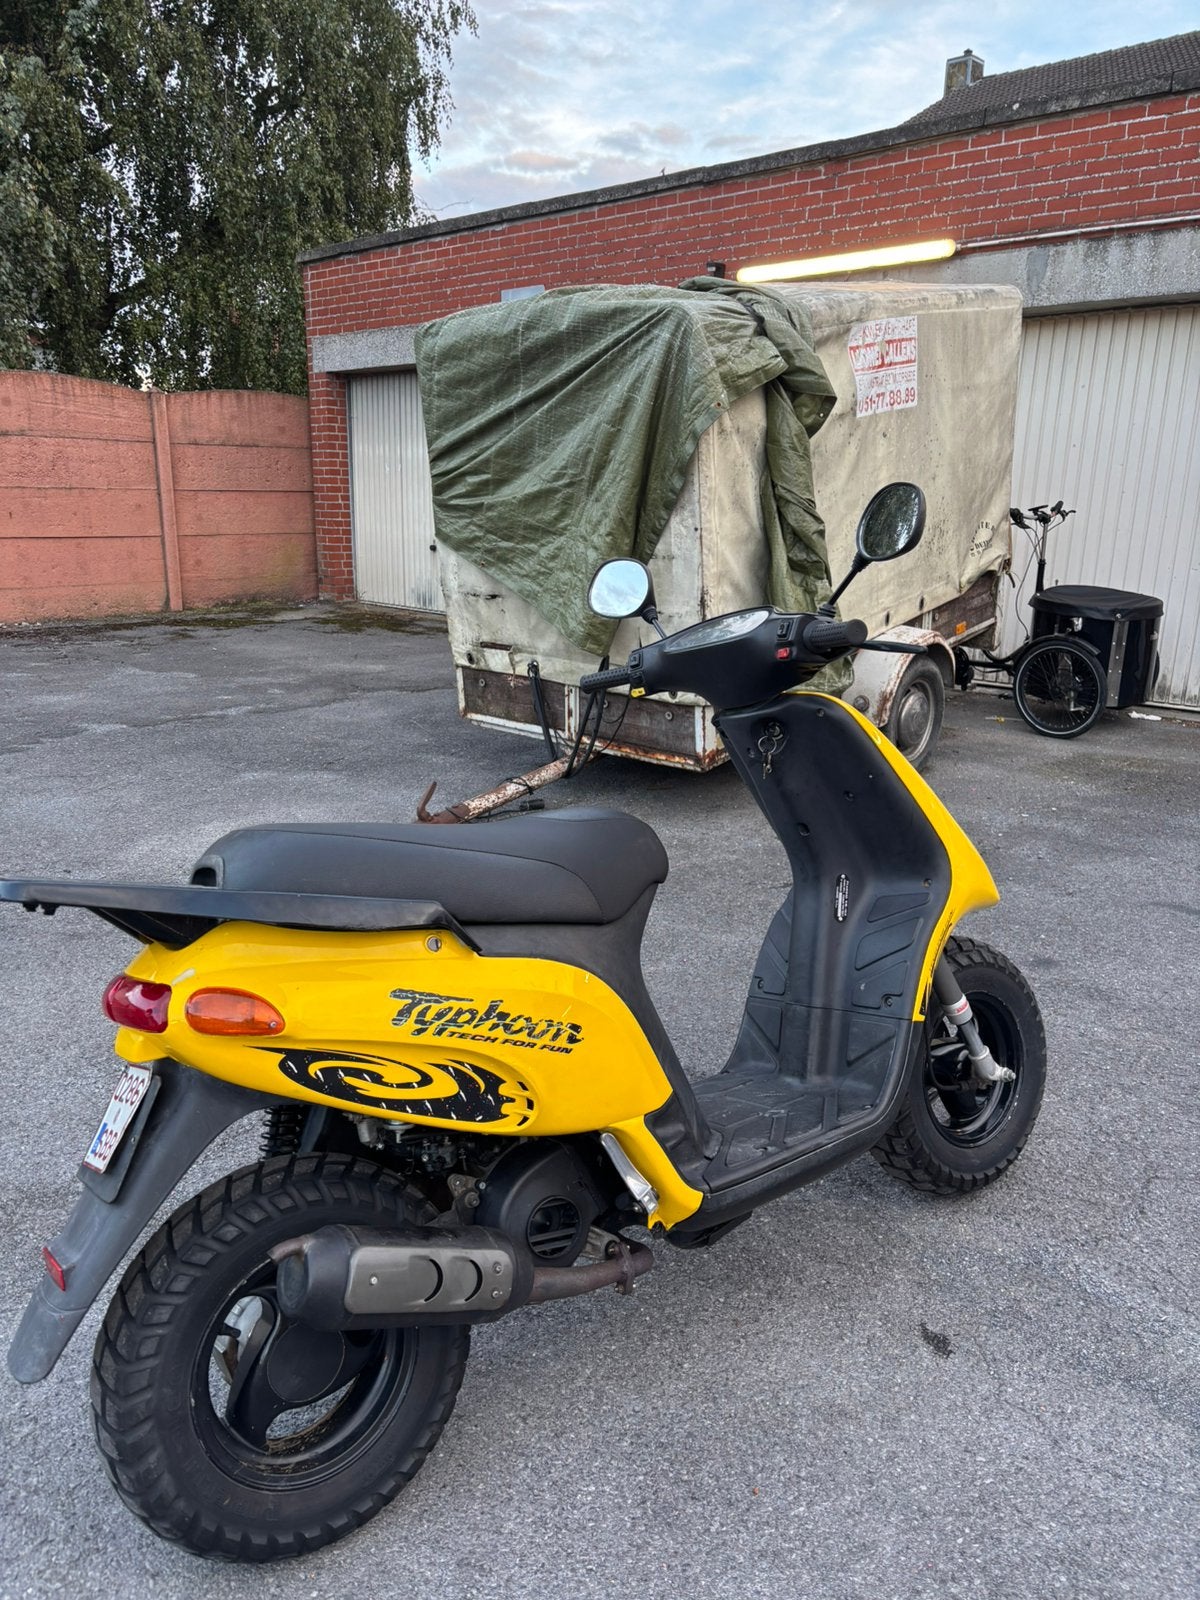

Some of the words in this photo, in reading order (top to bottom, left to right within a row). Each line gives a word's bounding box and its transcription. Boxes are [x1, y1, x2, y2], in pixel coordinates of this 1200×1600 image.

[389, 988, 585, 1045] Typhoon
[447, 1031, 499, 1043] TECH
[501, 1038, 537, 1049] FOR
[538, 1043, 574, 1055] FUN
